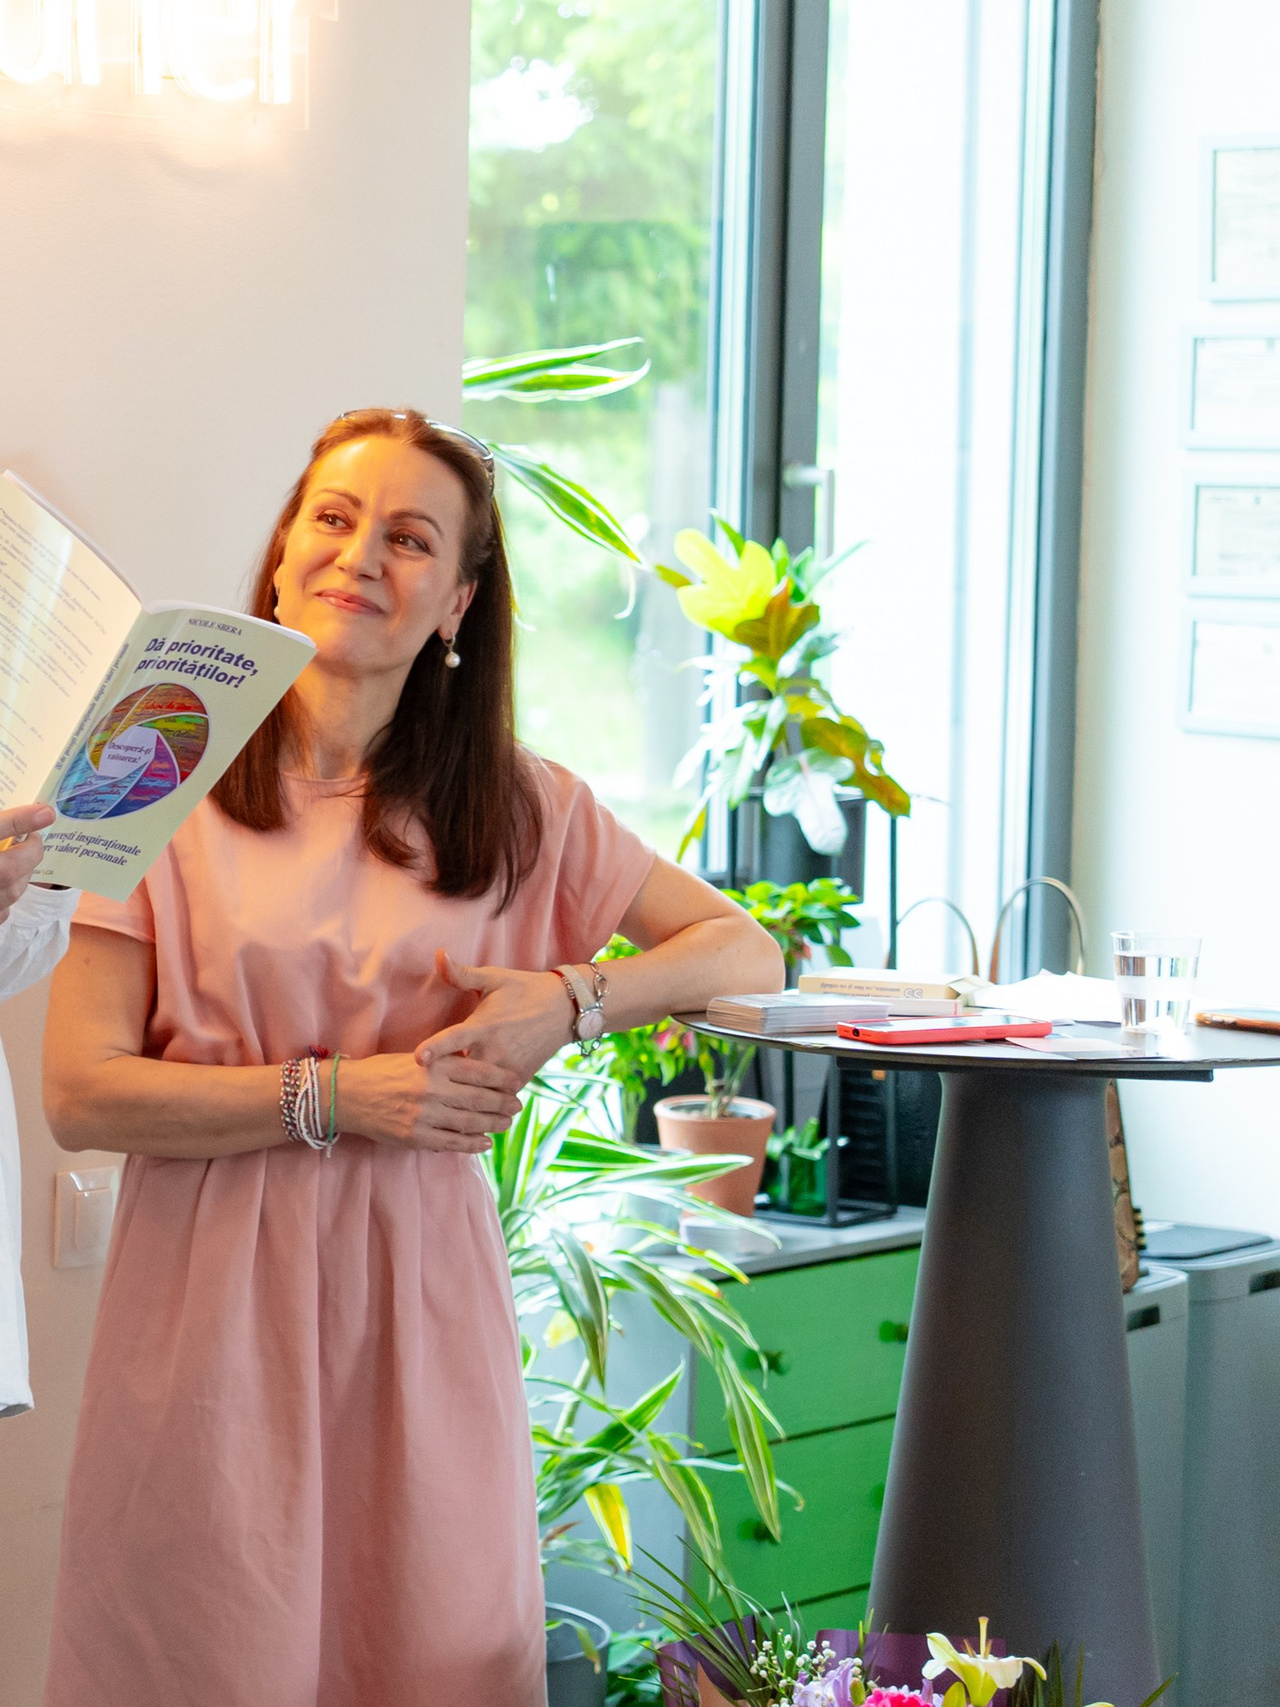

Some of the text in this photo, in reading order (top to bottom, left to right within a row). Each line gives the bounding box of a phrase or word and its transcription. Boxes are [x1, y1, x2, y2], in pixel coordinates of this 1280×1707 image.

[187, 618, 243, 636] NICOLE SBERA
[144, 637, 259, 676] Dă prioritate,
[133, 656, 246, 689] priorităților!
[44, 831, 142, 856] povești inspiraționale
[54, 844, 82, 854] valori
[79, 848, 128, 866] personale
